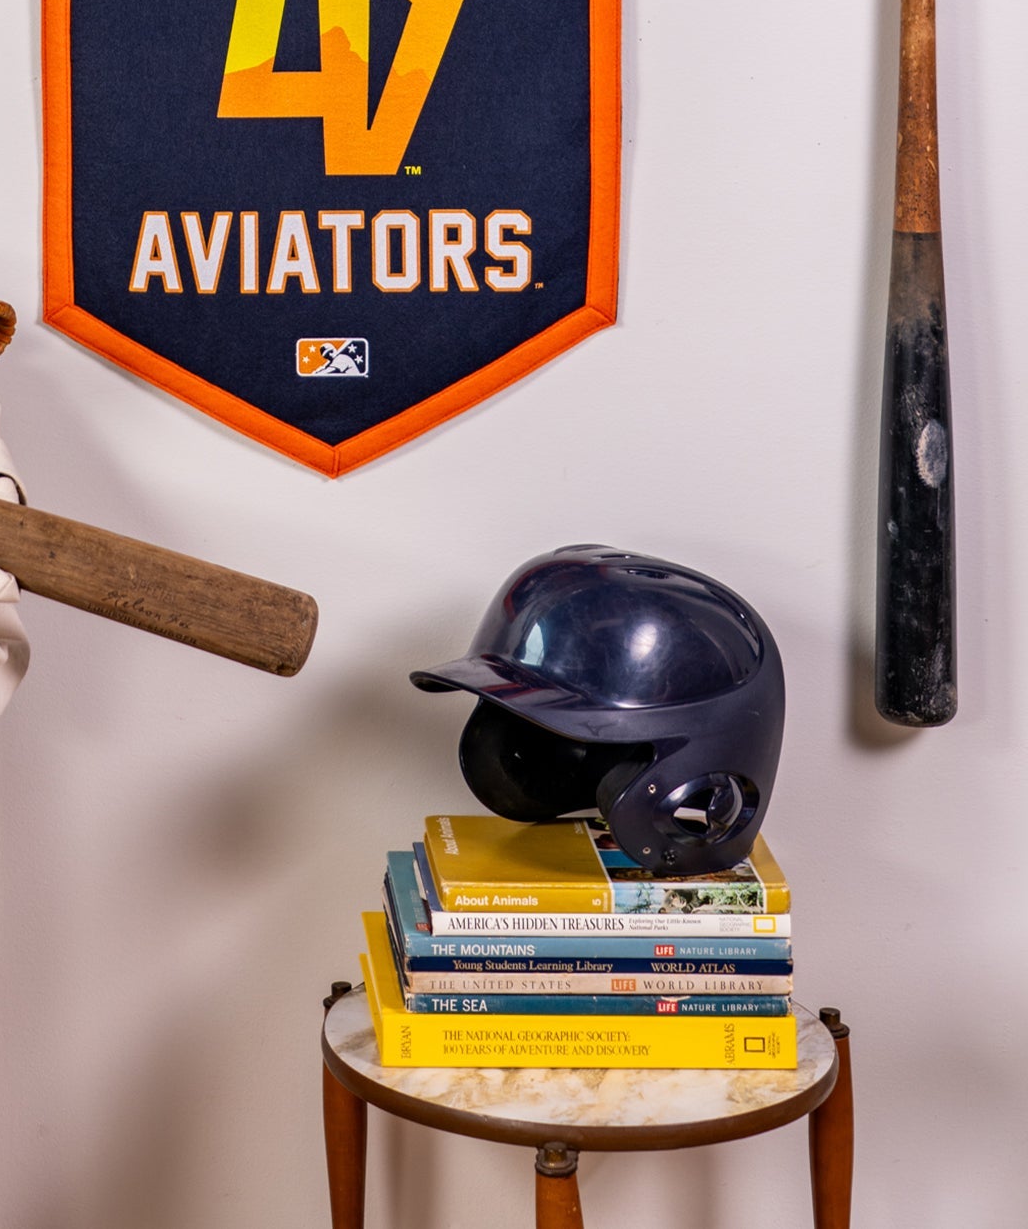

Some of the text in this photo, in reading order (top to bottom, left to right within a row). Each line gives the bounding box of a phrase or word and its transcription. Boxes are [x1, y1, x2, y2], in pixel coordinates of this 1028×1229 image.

[129, 209, 533, 294] AVIATORS
[454, 895, 489, 906] About
[491, 895, 539, 906] Animals
[592, 898, 602, 906] 5
[447, 917, 625, 931] AMERICA'S HIDDEN TREASURES
[431, 944, 536, 956] THE MOUNTAINS
[655, 946, 758, 956] LIFE NATURE LIBRARY
[452, 959, 614, 972] Young Students Learning Library
[650, 962, 736, 973] WORLD ATLAS
[429, 979, 571, 989] THE UNITED STATES
[613, 980, 765, 991] LIFE WORLD LIBRARY
[431, 999, 488, 1011] THE SEA
[658, 1002, 760, 1012] LIFE NATURE LIBRARY
[401, 1025, 412, 1059] BRYAN
[443, 1030, 631, 1042] THE NATIONAL GEOGRAPHIC SOCIETY:
[724, 1023, 735, 1065] ABRAMS
[443, 1045, 651, 1056] 100 YEARS OF ADVENTURE AND DISCOVERY
